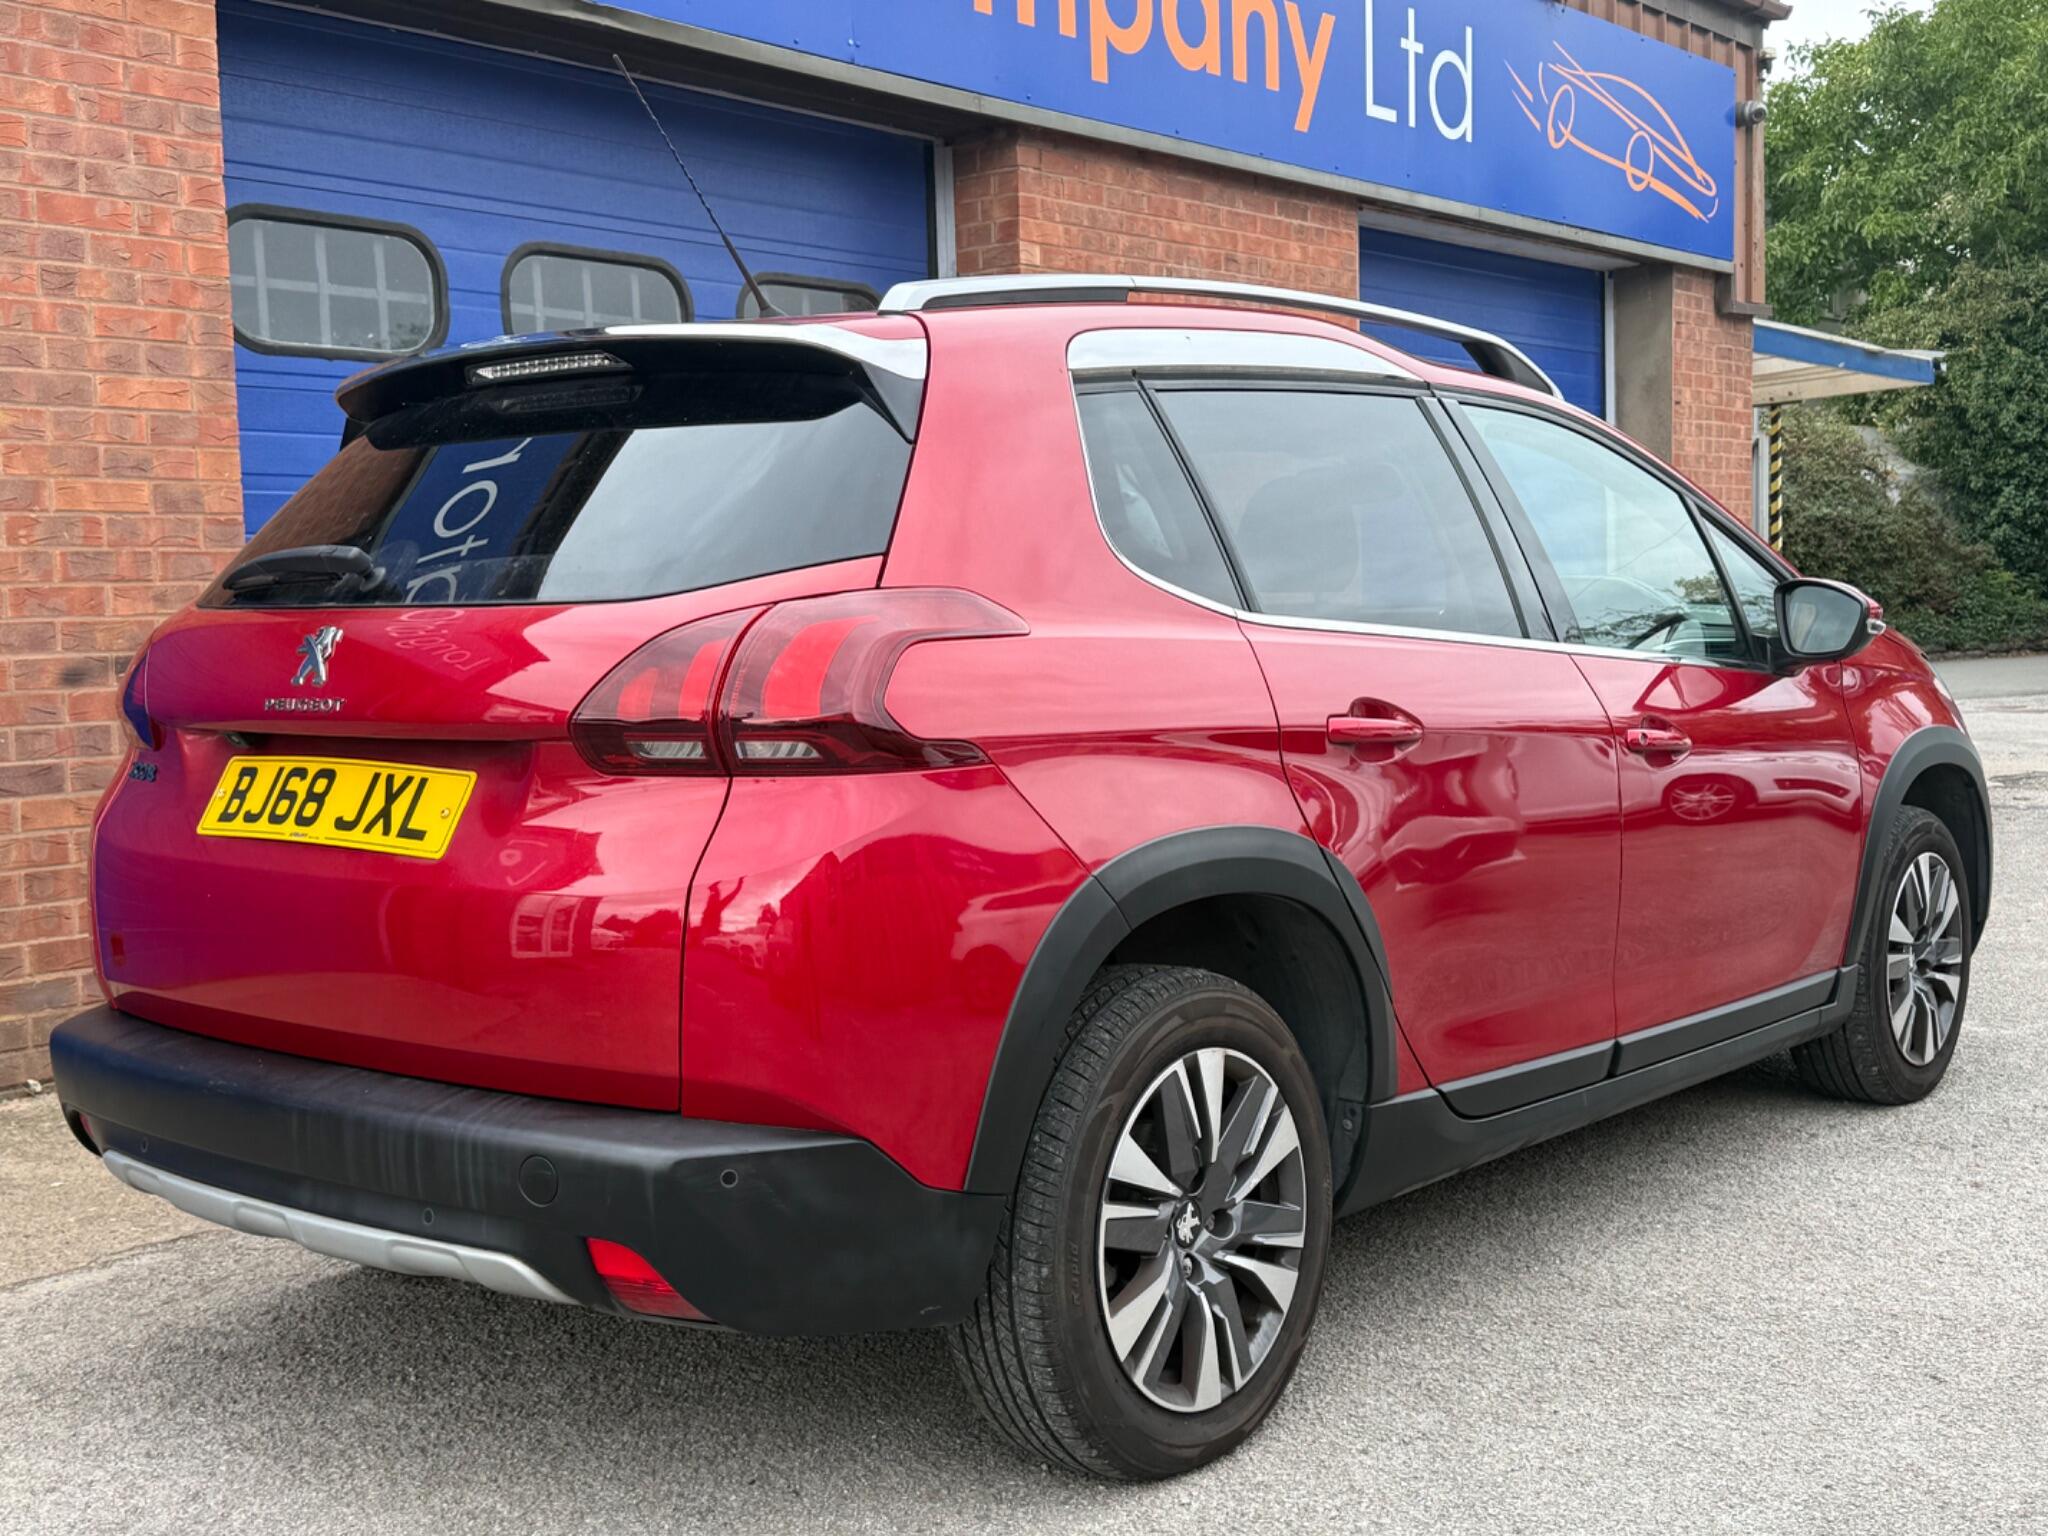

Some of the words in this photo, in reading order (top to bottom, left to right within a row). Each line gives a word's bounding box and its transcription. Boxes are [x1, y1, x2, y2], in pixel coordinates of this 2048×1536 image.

[973, 0, 1336, 133] pany
[1365, 0, 1473, 143] Ltd
[264, 697, 347, 713] PEUGEOT
[217, 766, 337, 828] BJ68
[334, 772, 430, 841] JXL
